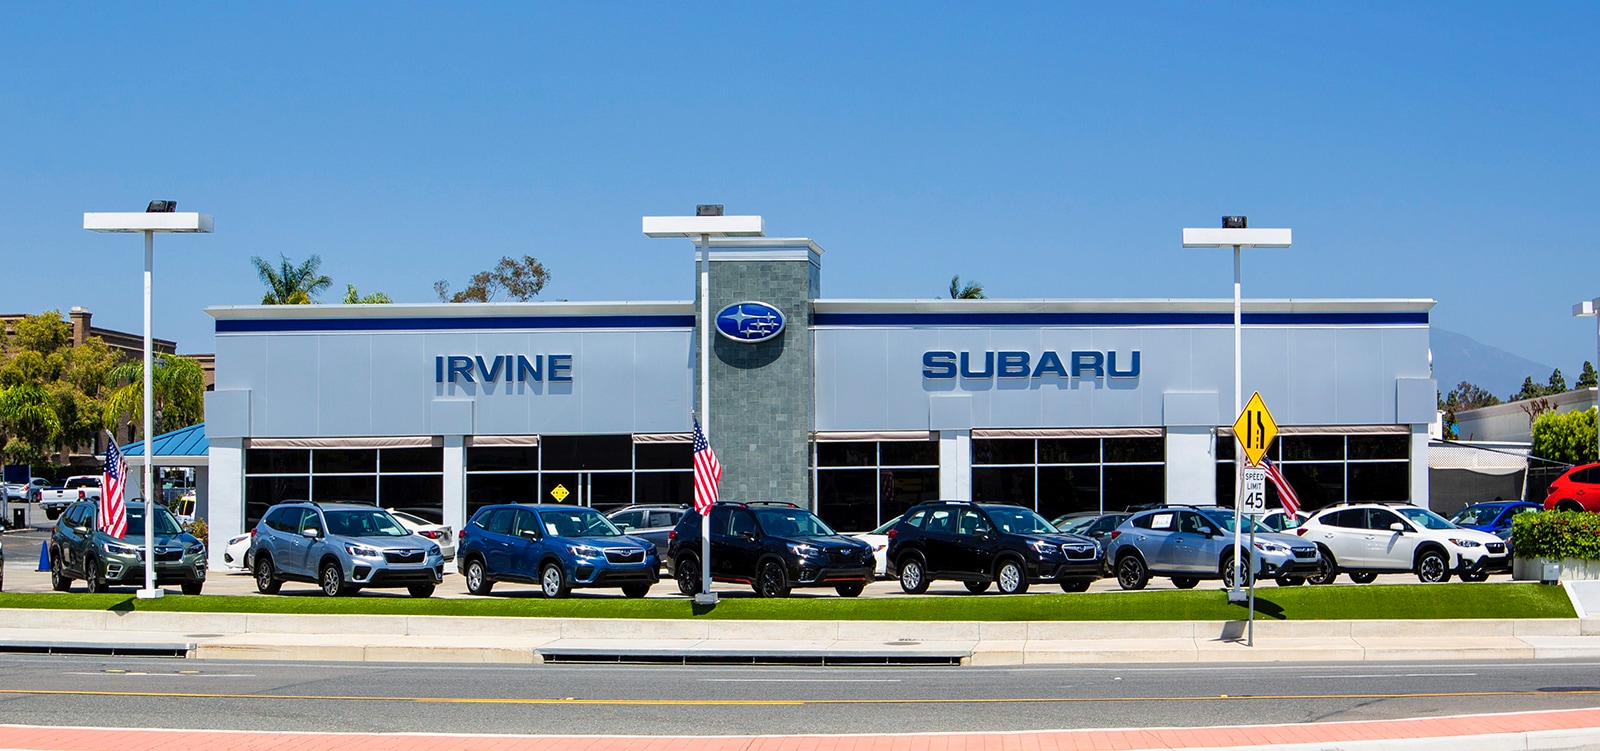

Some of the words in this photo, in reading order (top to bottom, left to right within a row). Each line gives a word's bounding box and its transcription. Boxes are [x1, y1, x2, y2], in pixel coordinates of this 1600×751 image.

[436, 354, 573, 383] IRVINE
[922, 351, 1141, 379] SUBARU
[1245, 473, 1264, 481] SPEED
[1245, 492, 1263, 509] 45
